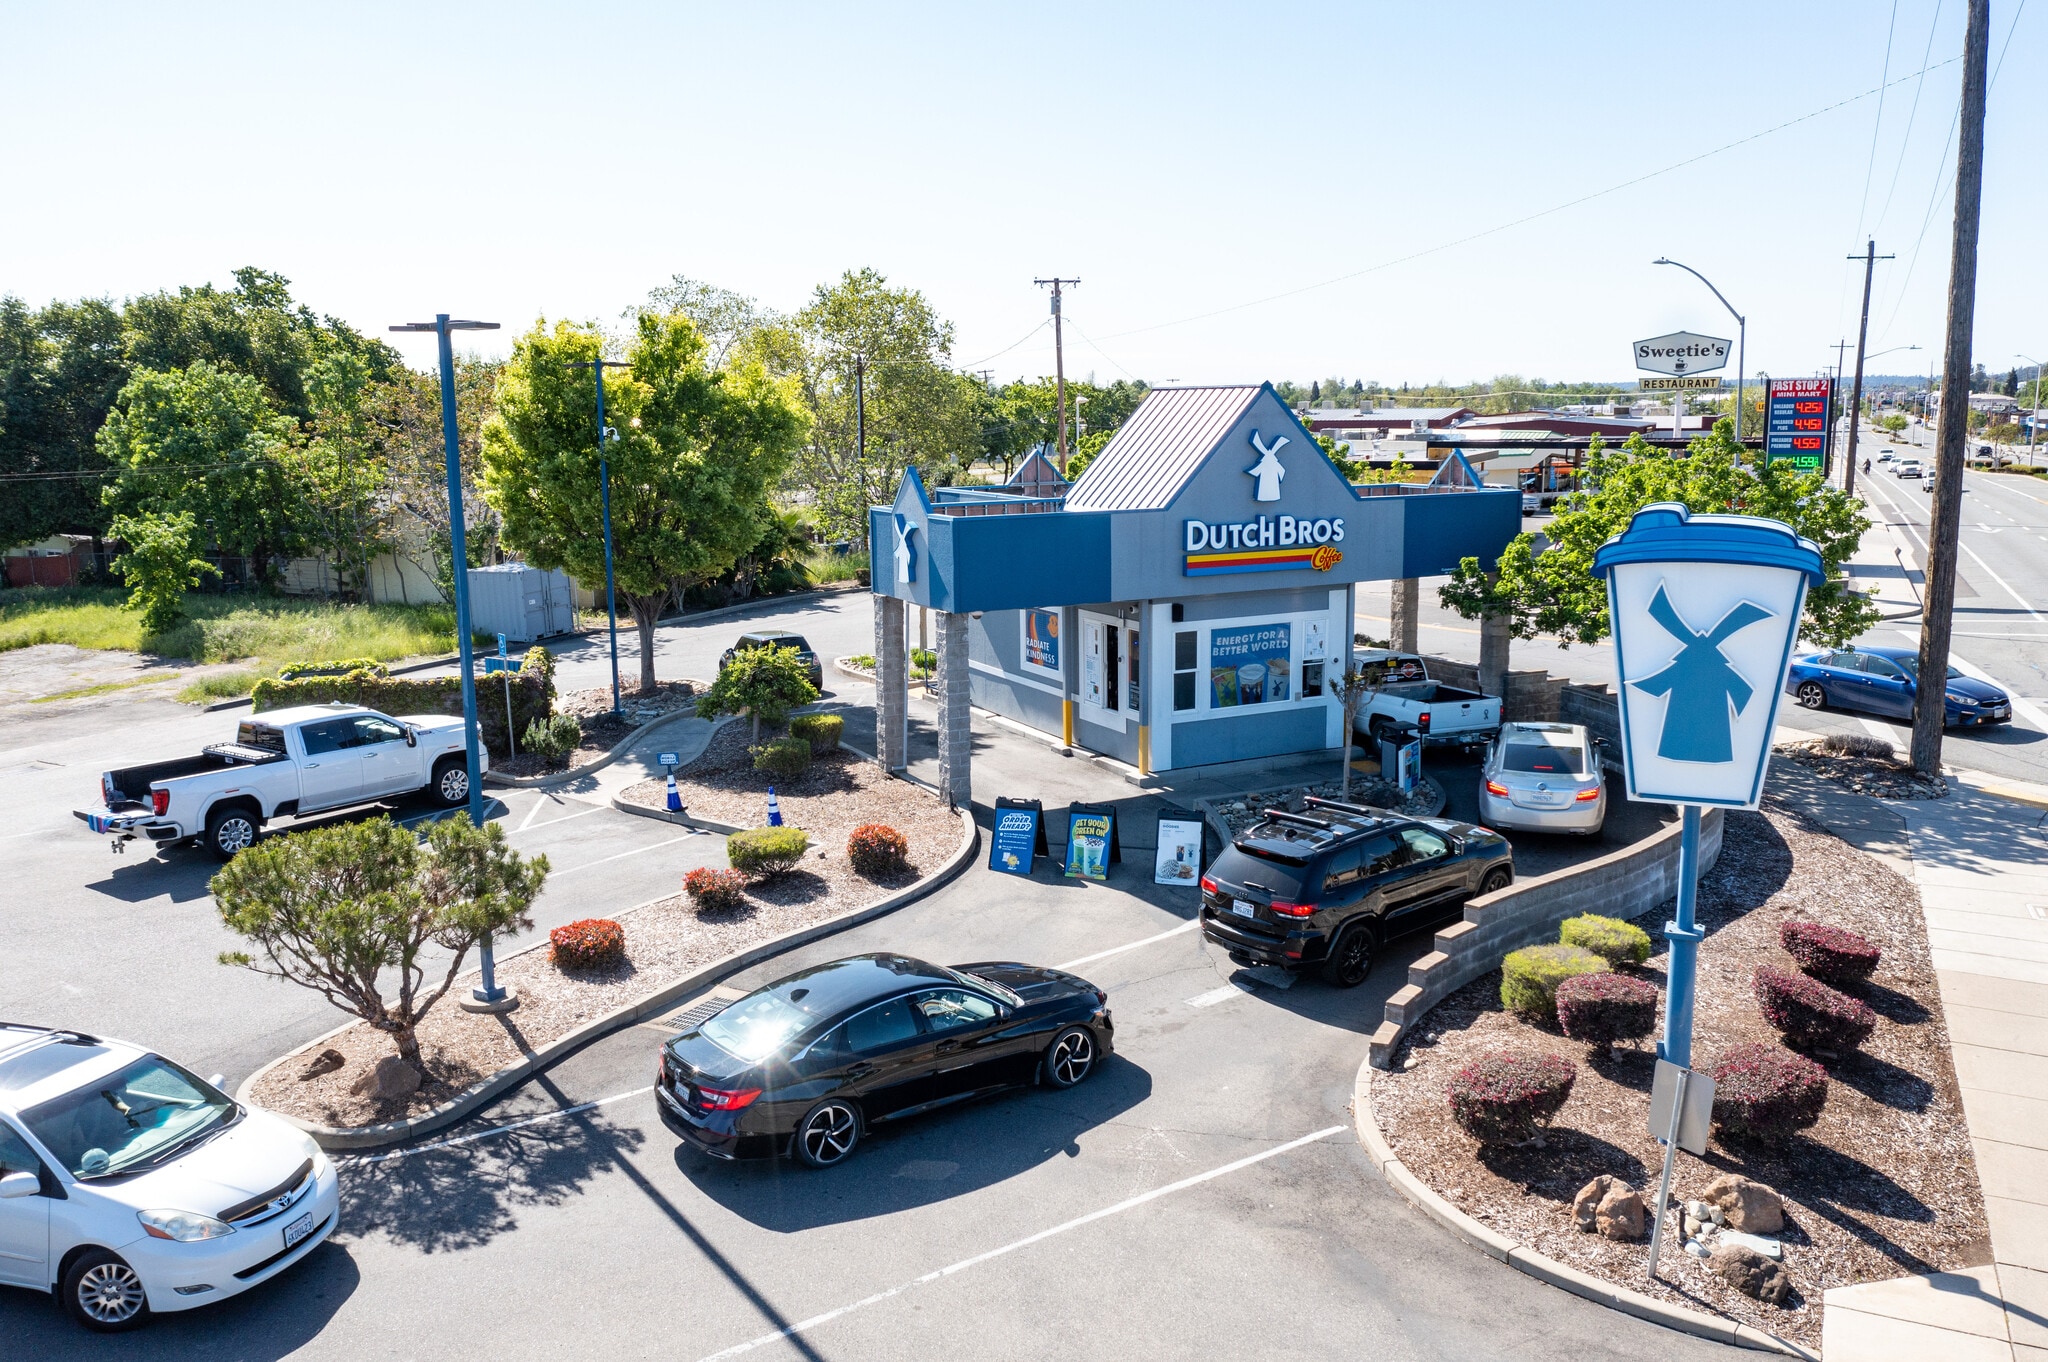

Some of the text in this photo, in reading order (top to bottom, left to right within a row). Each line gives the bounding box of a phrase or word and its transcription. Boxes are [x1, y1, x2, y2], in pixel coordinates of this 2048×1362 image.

[1638, 343, 1724, 358] Sweetie's
[1643, 378, 1717, 389] RESTAURANT
[1772, 380, 1827, 391] FAST STOP 2
[1795, 402, 1819, 413] 4.25
[1794, 419, 1817, 430] 4.45
[1793, 438, 1817, 449] 4.55
[1792, 456, 1815, 467] 4.59
[1184, 514, 1345, 552] DUTCH BROS
[1312, 545, 1342, 571] Coffee
[1216, 630, 1285, 646] ENERGY FOR A
[1026, 637, 1050, 651] RADIATE
[1212, 640, 1289, 656] BETTER WORLD
[1026, 649, 1055, 664] KINDNESS
[1075, 819, 1106, 828] GET YOUR
[1075, 827, 1106, 837] GREEN ON
